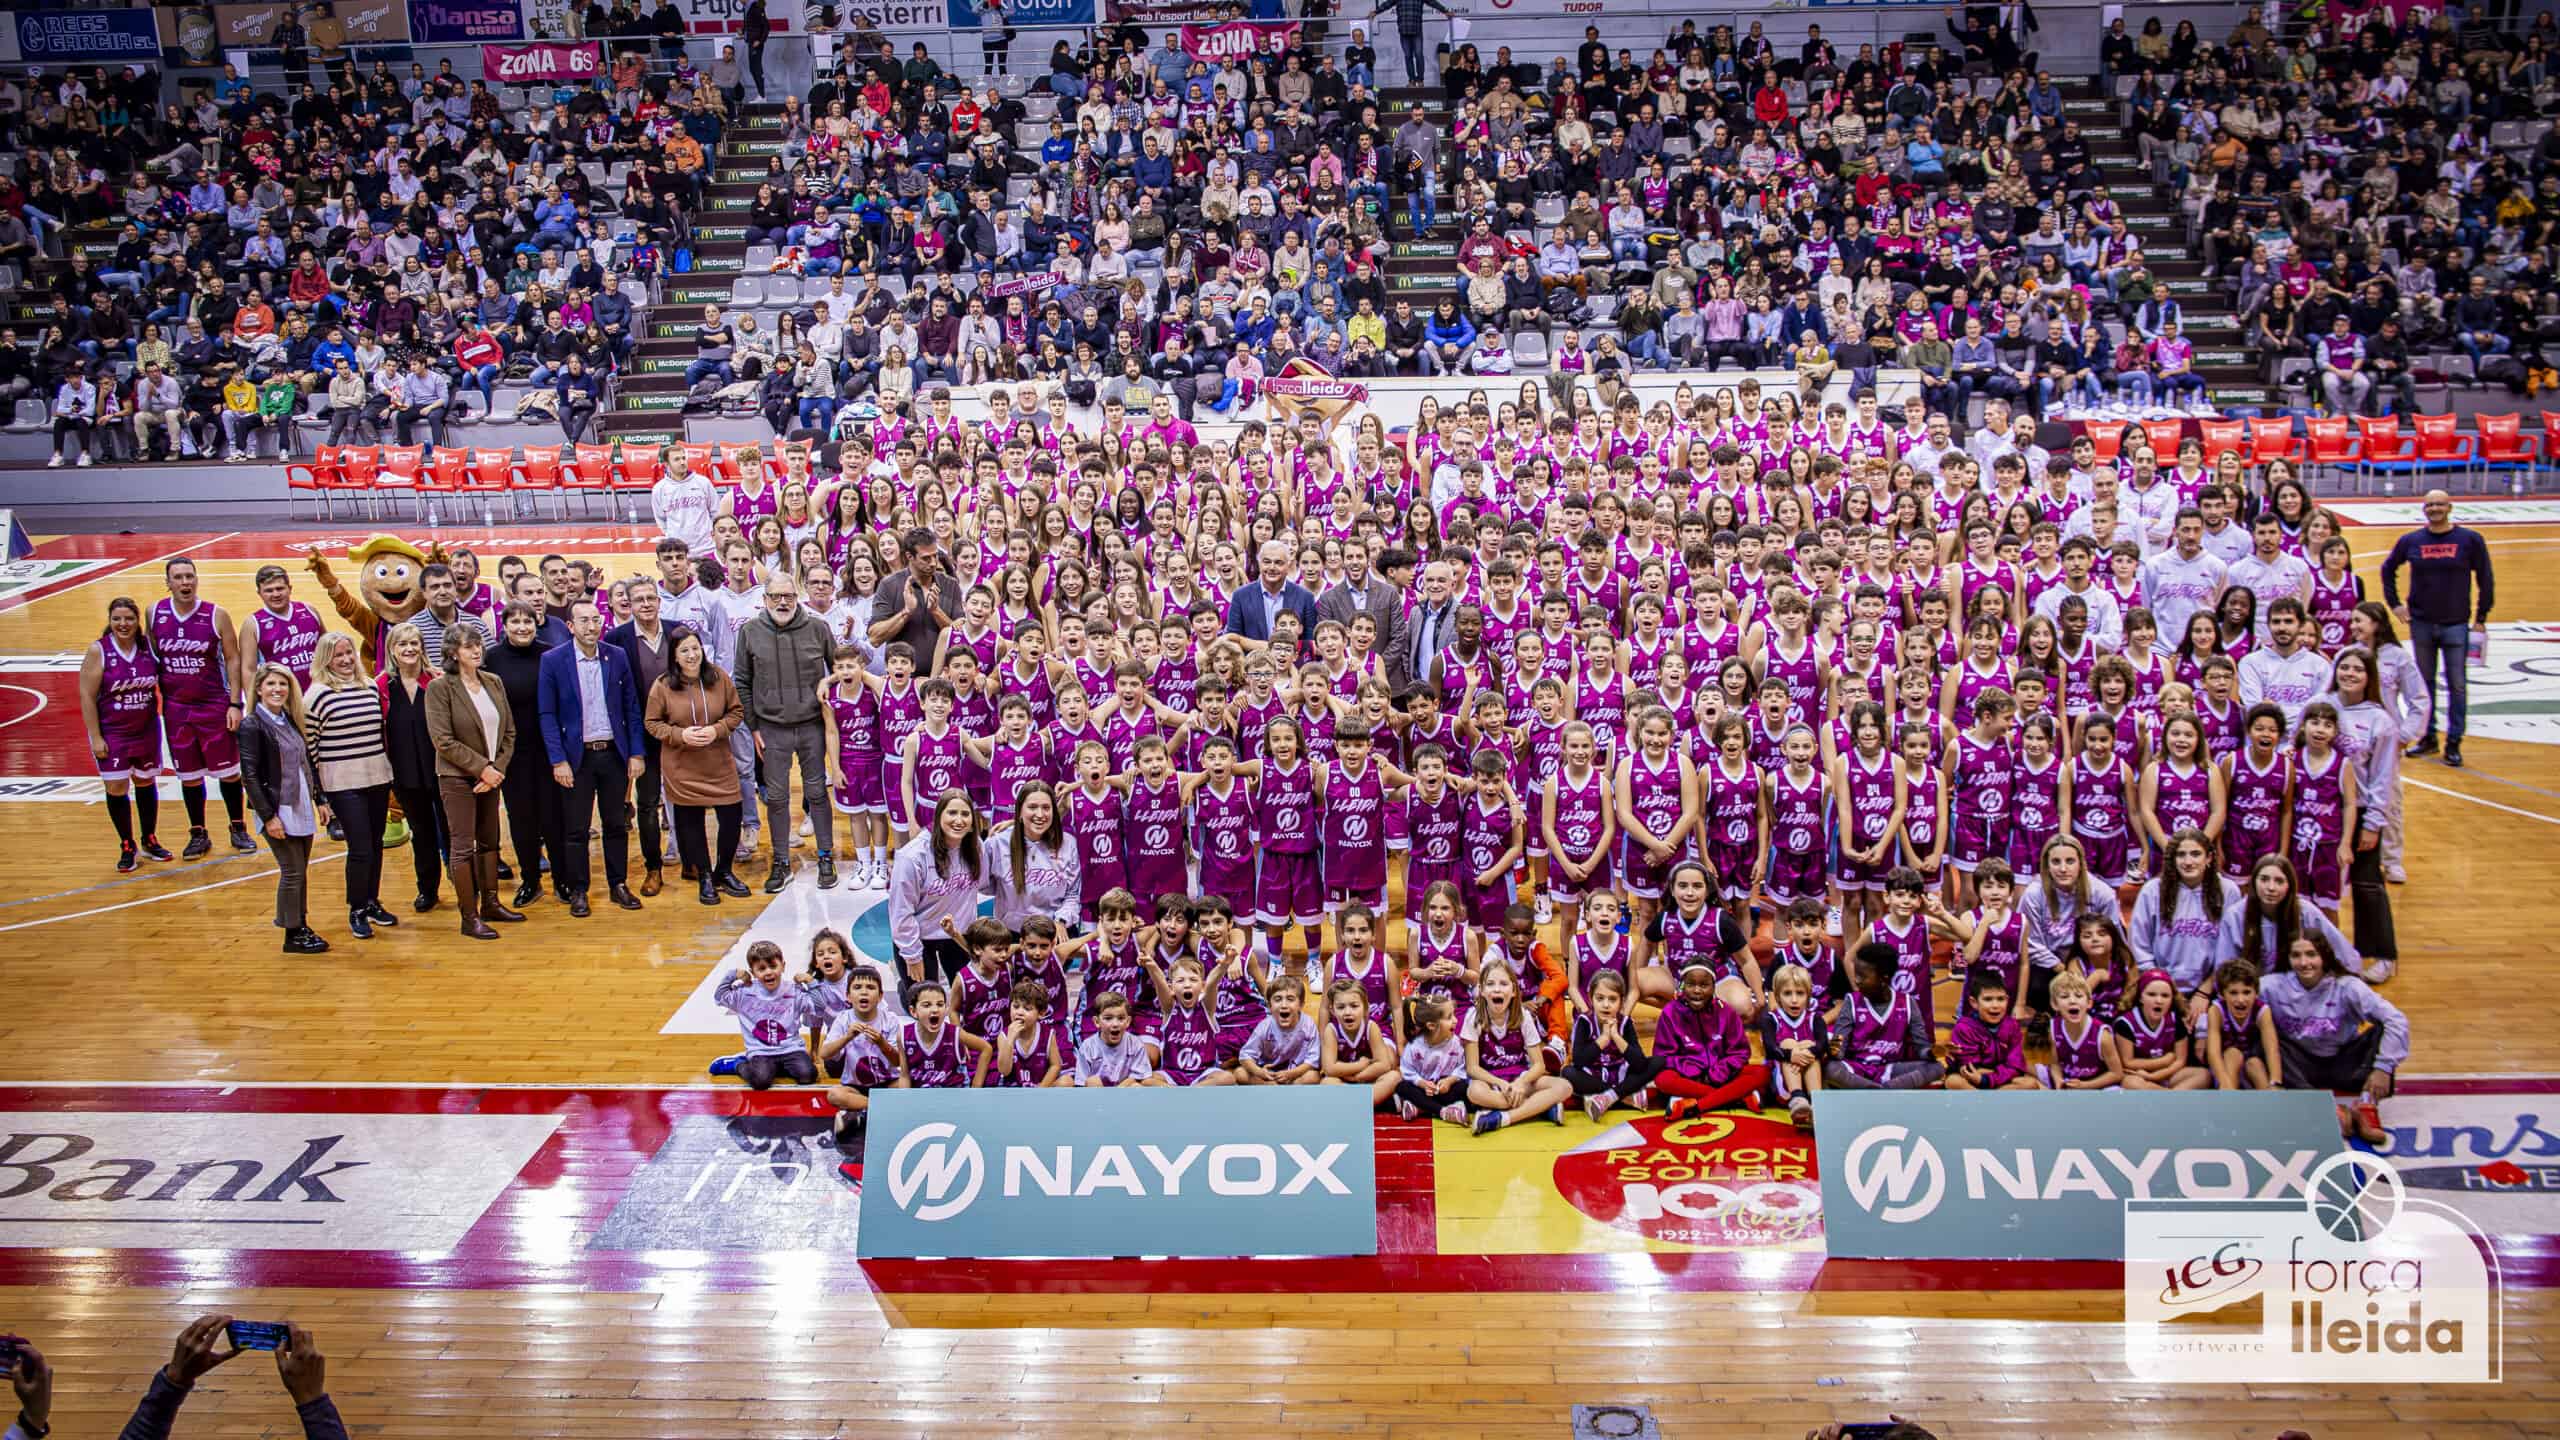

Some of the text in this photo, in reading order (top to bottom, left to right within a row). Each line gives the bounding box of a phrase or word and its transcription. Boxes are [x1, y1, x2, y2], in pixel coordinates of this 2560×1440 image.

[850, 3, 943, 24] esterri
[1562, 3, 1603, 12] TUDOR
[44, 15, 109, 33] REGS
[1196, 29, 1285, 56] ZONA 5
[499, 48, 557, 75] ZONA
[178, 627, 184, 638] 6
[287, 626, 298, 635] 10
[159, 638, 209, 653] LLEIDA
[171, 655, 206, 668] atlas
[290, 650, 315, 664] atla
[130, 667, 137, 676] 7
[113, 757, 119, 767] 7
[919, 754, 958, 768] LLEIDA
[1000, 764, 1040, 779] LLEIDA
[1265, 792, 1311, 807] LLEIDA
[1349, 786, 1360, 798] 00
[1331, 798, 1379, 813] LLEIDA
[1134, 808, 1179, 822] LLEIDA
[1207, 814, 1245, 828] LLEIDA
[1080, 820, 1119, 834] LLEIDA
[1417, 820, 1459, 835] LLEIDA
[1271, 831, 1305, 839] NAYOX
[1464, 828, 1503, 846] LLEIDA
[1338, 839, 1373, 848] NAYOX
[1139, 848, 1175, 857] NAYOX
[1097, 966, 1138, 981] LLEIDA
[1168, 1029, 1208, 1045] LLEIDA
[1019, 1069, 1031, 1080] 10
[1606, 1148, 1809, 1165] RAMON
[0, 1132, 373, 1207] Bank
[1002, 1143, 1352, 1197] NAYOX
[1615, 1164, 1809, 1182] SOLER
[1961, 1148, 2330, 1200] NAYOX
[1622, 1183, 1822, 1221] 100
